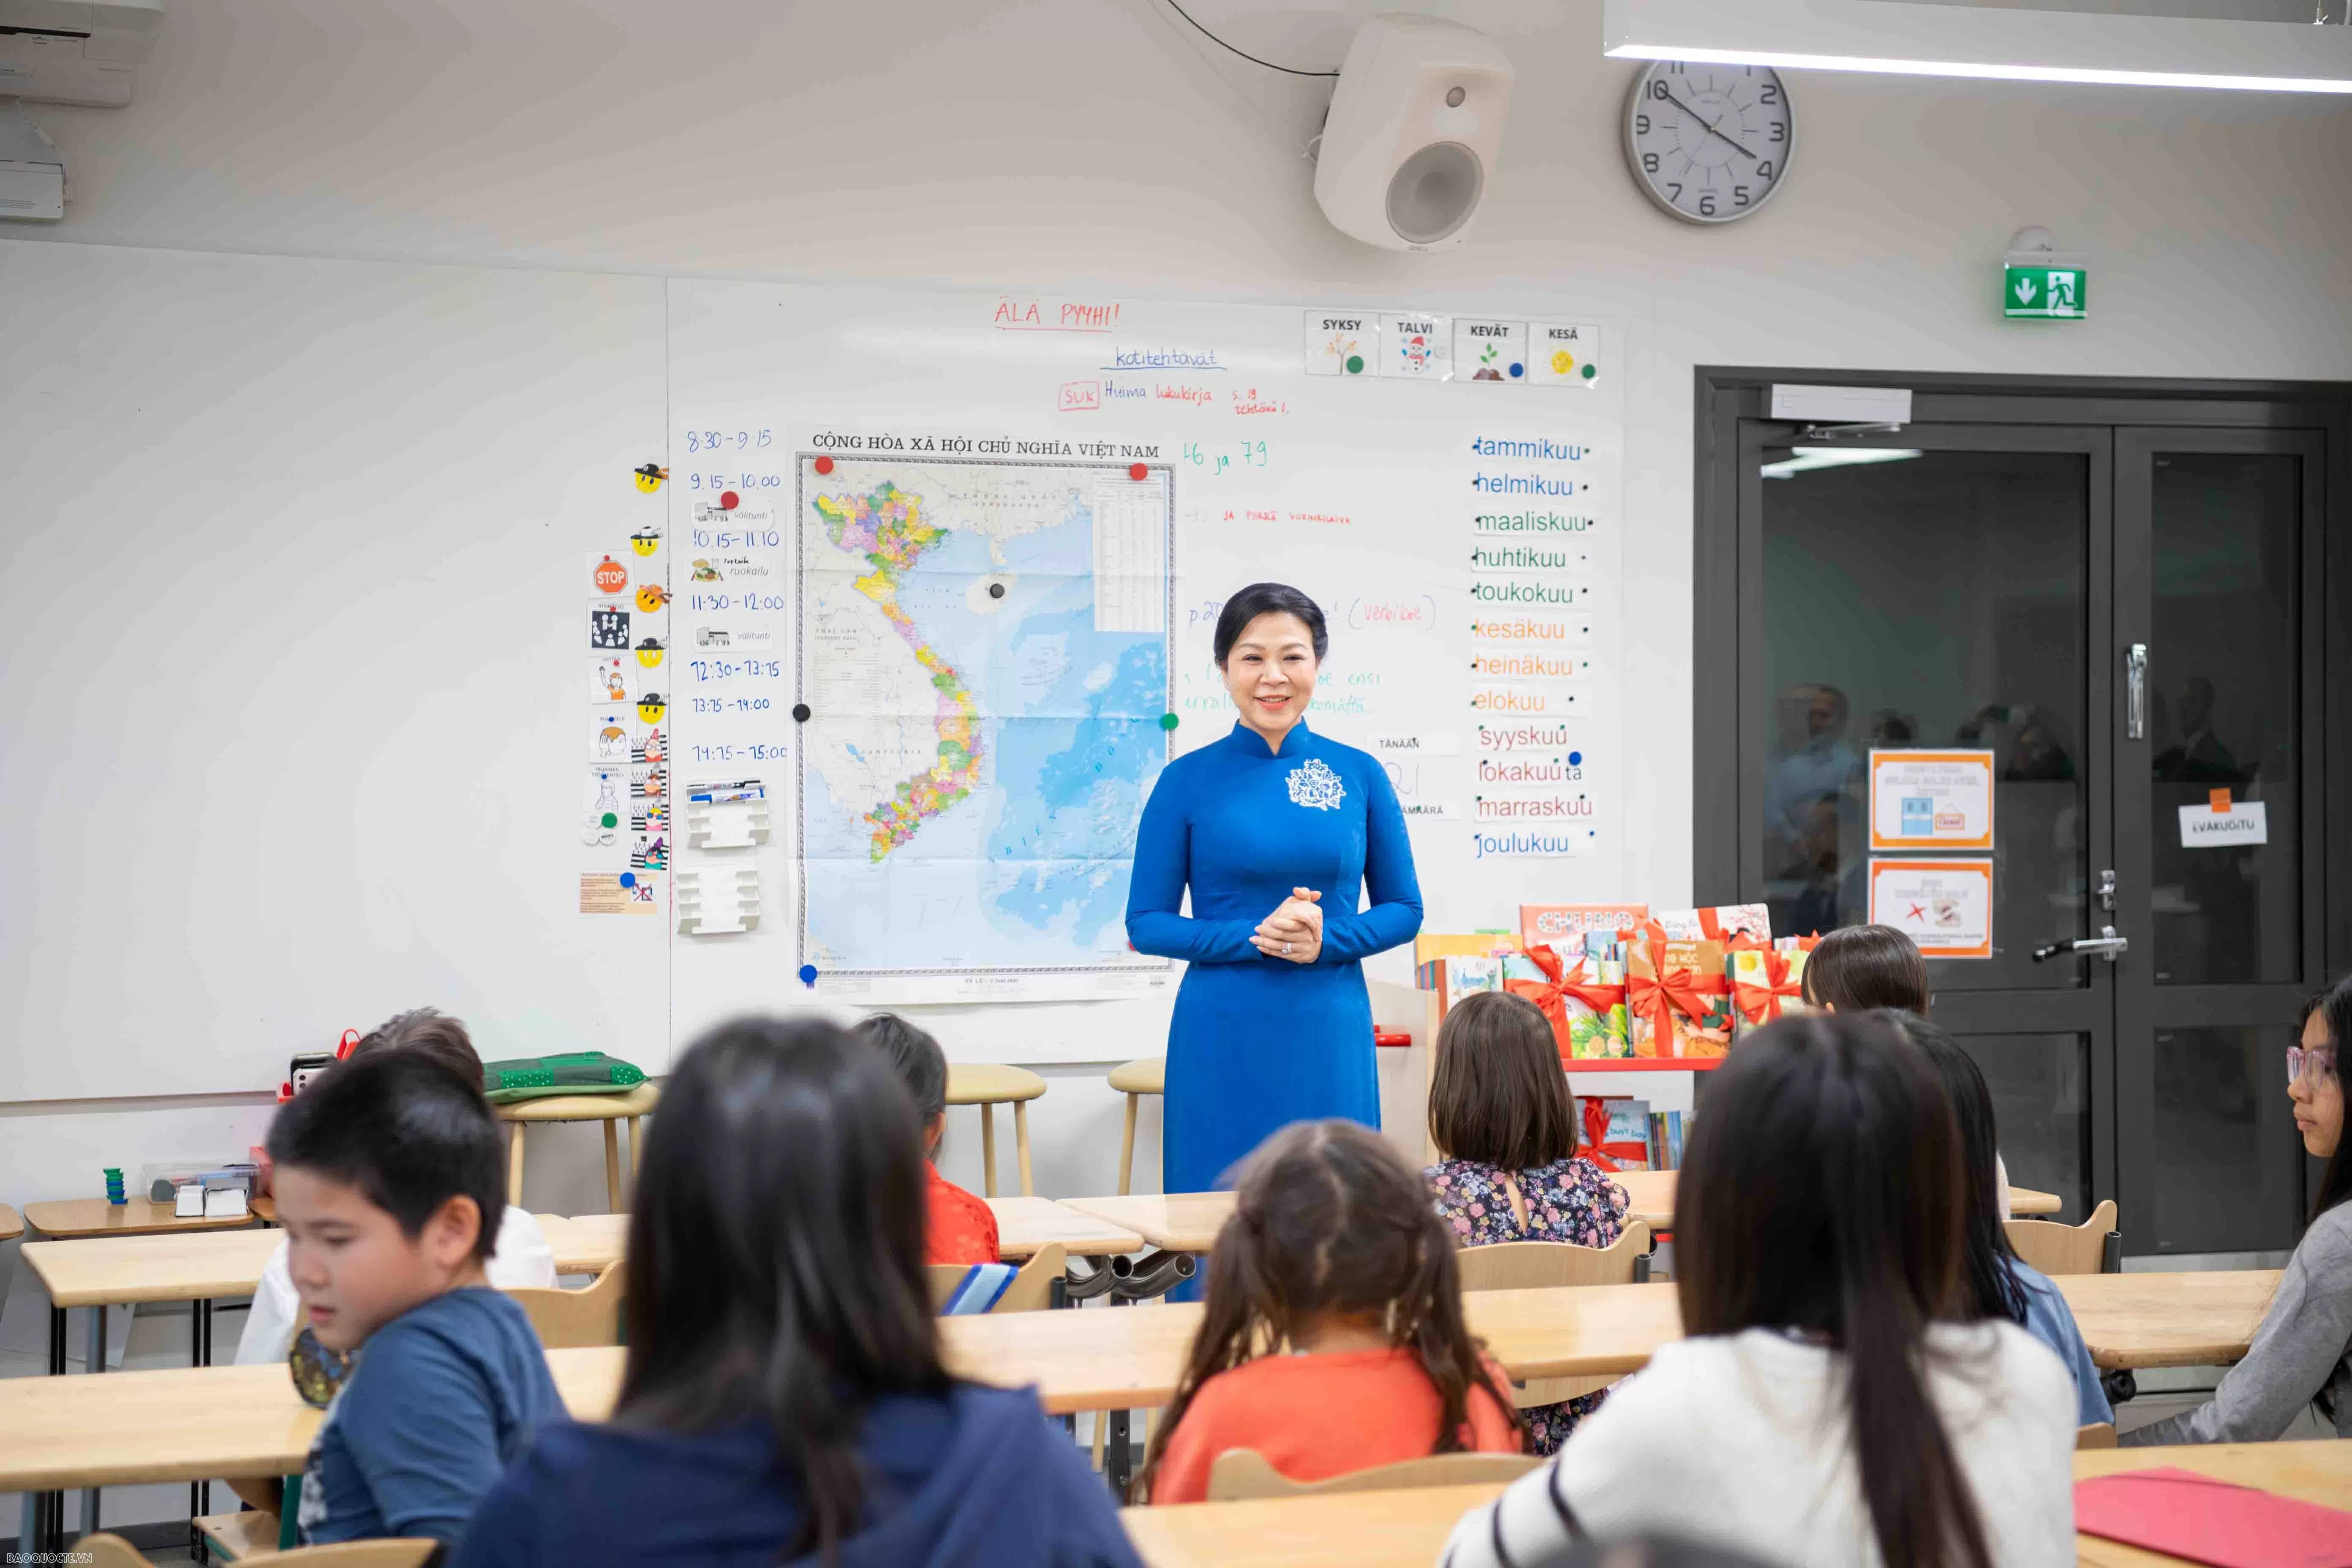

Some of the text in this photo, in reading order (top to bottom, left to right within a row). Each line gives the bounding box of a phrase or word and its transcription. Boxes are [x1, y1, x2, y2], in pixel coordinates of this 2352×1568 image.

[1647, 79, 1669, 100] 10
[1760, 84, 1777, 104] 2
[1636, 114, 1650, 135] 9
[1769, 121, 1785, 142] 3
[1643, 152, 1659, 173] 8
[1756, 160, 1773, 181] 4
[1667, 182, 1682, 203] 7
[1734, 186, 1749, 206] 5
[1699, 196, 1715, 216] 6
[1323, 318, 1362, 331] SYKSY
[1397, 321, 1433, 335] TALVI
[1470, 324, 1509, 338] KEVÄT
[1548, 327, 1579, 340] KESÄ
[813, 431, 1160, 460] CỘNG HÒA XÃ HỘI CHỦ NGHĨA VIỆT NAM
[1478, 436, 1581, 460] tammikuu
[1477, 471, 1573, 496] helmikuu
[1478, 511, 1586, 531] maaliskuu
[1475, 547, 1566, 568] huhtikuu
[596, 570, 626, 585] STOP
[730, 565, 769, 575] ruokailu
[1476, 581, 1573, 604] toukokuu
[1475, 618, 1565, 639] kesäkuu
[1476, 655, 1573, 676] heinäkuu
[1474, 690, 1546, 711] elokuu
[1480, 725, 1568, 751] syyskuu
[1479, 796, 1592, 817] marraskuu
[1477, 832, 1569, 858] joulukuu
